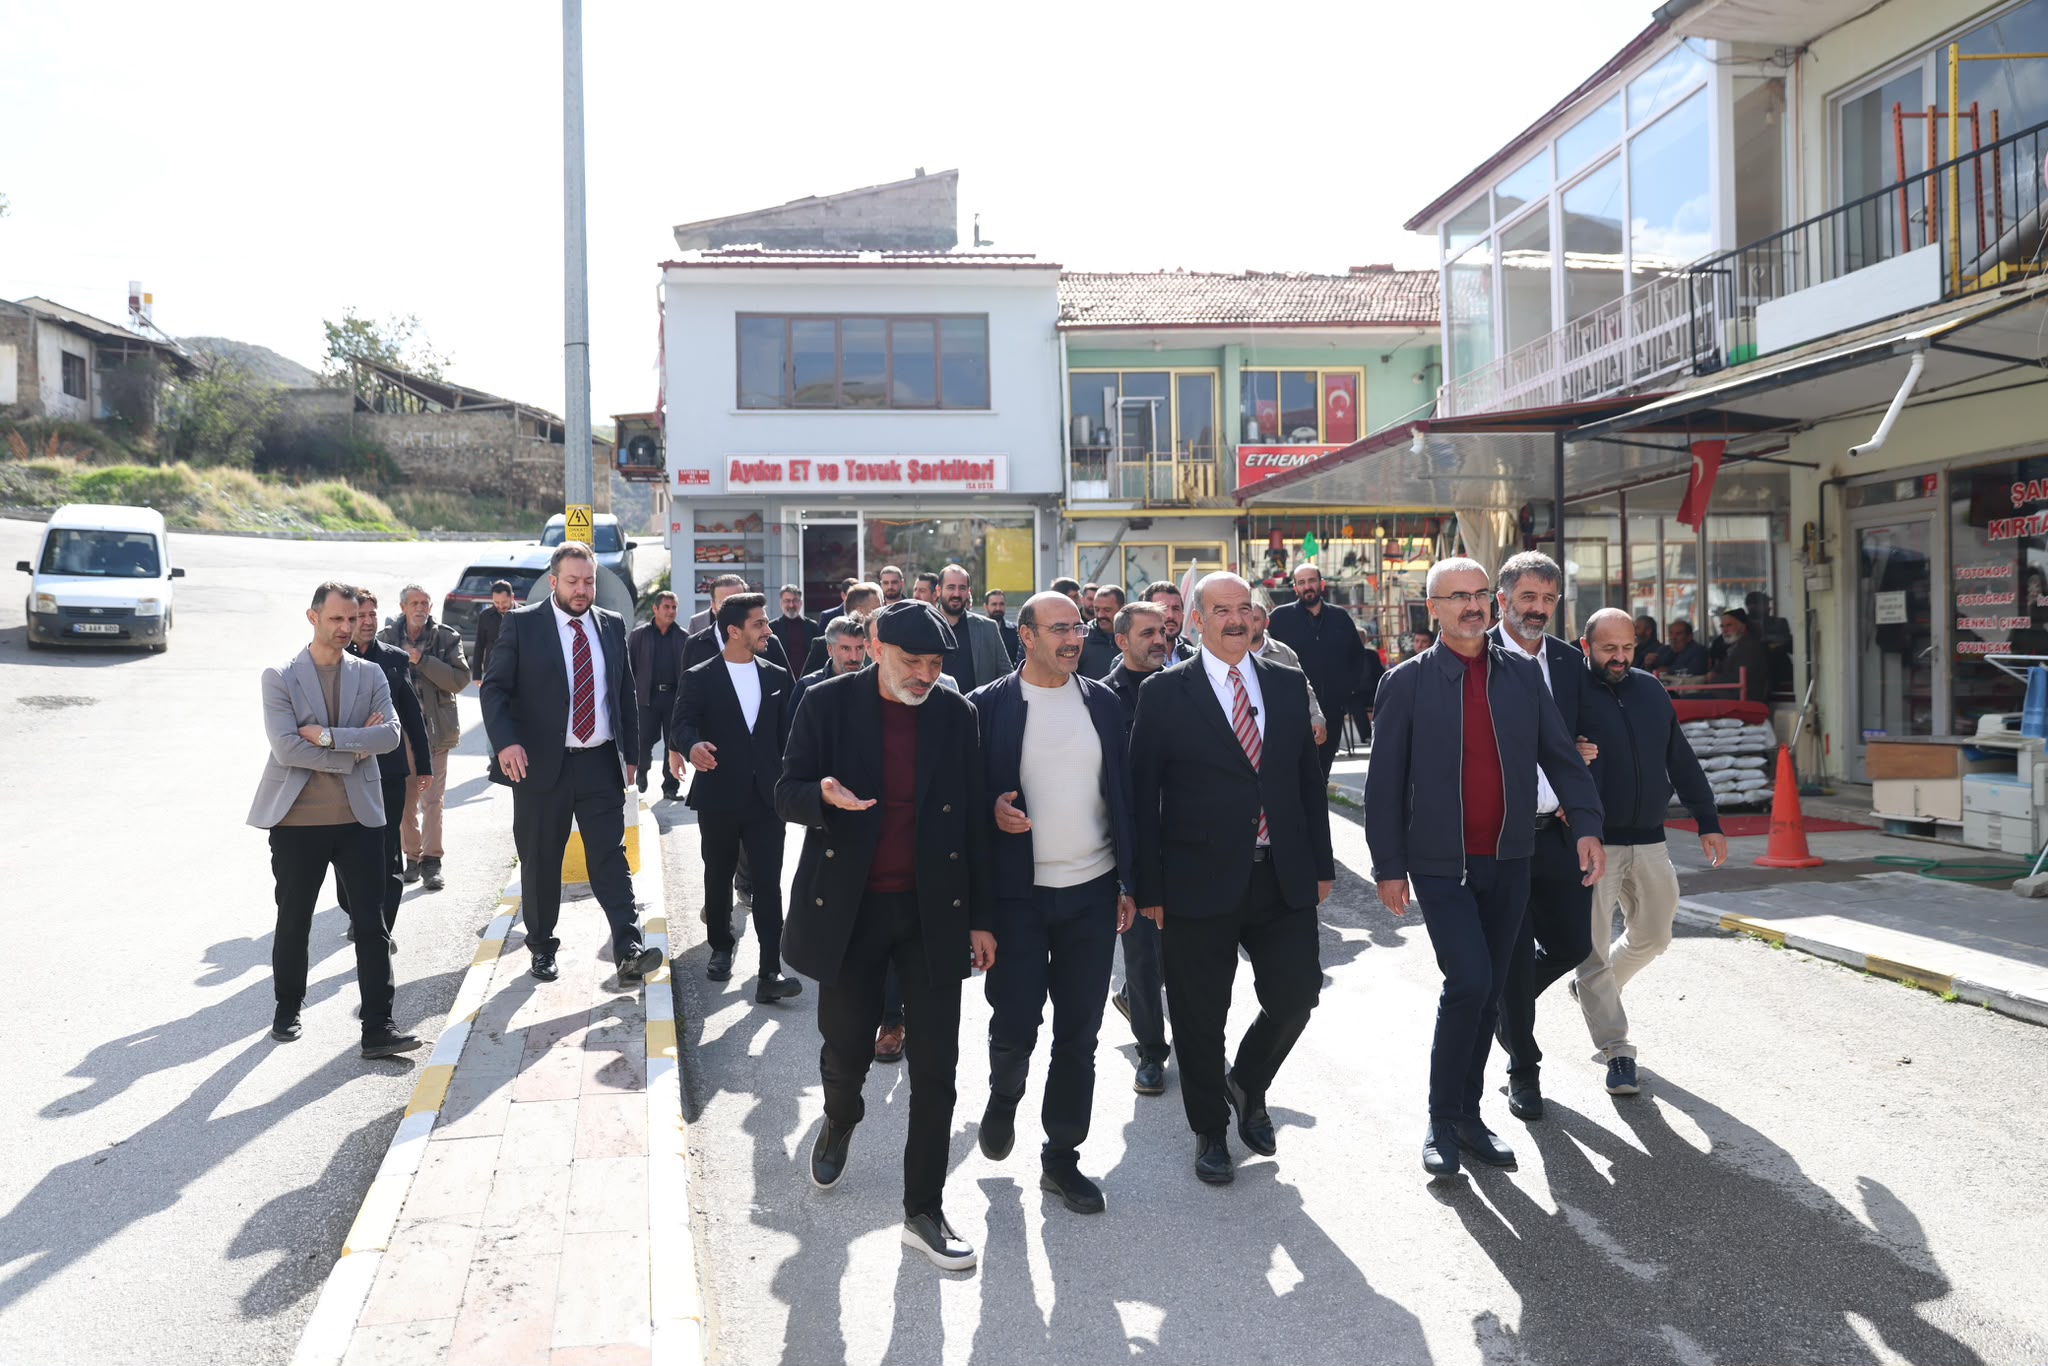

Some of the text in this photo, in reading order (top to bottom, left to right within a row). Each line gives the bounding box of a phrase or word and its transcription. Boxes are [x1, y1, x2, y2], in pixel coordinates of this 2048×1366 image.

[1245, 451, 1330, 467] ETHEMO
[730, 459, 994, 484] Aydın ET ve Tavuk Şarküteri
[1957, 614, 2031, 632] RENKLİ ÇIKTI
[1957, 641, 2012, 654] OYUNCAK
